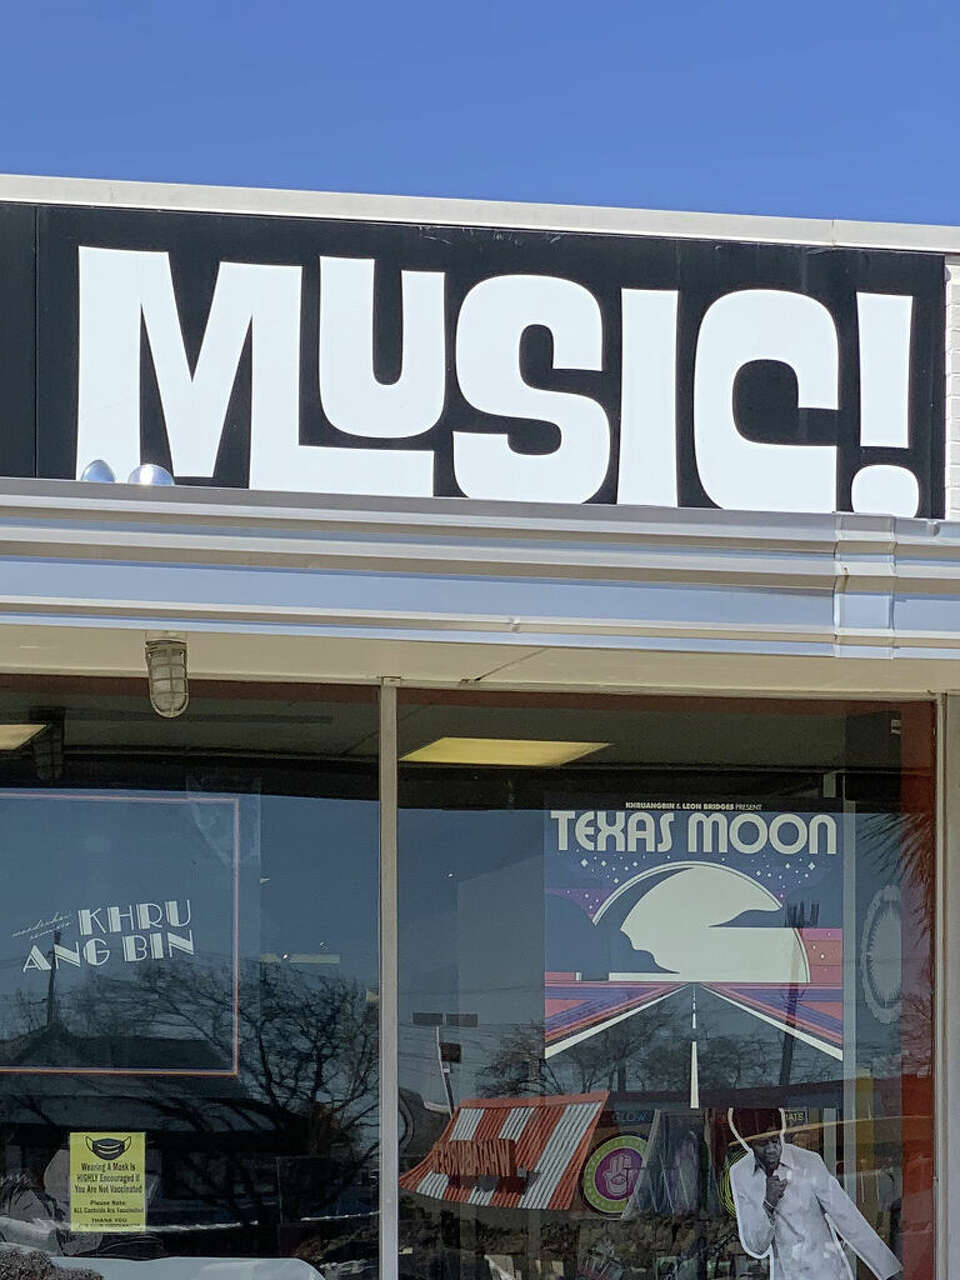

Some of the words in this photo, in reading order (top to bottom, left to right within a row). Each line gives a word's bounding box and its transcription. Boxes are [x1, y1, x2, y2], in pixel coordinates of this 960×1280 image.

[75, 245, 919, 518] MUSIC!
[550, 810, 675, 853] TEXAS
[688, 812, 837, 855] MOON
[77, 899, 192, 936] KHRU
[23, 938, 111, 973] ANG
[121, 930, 195, 962] BIN
